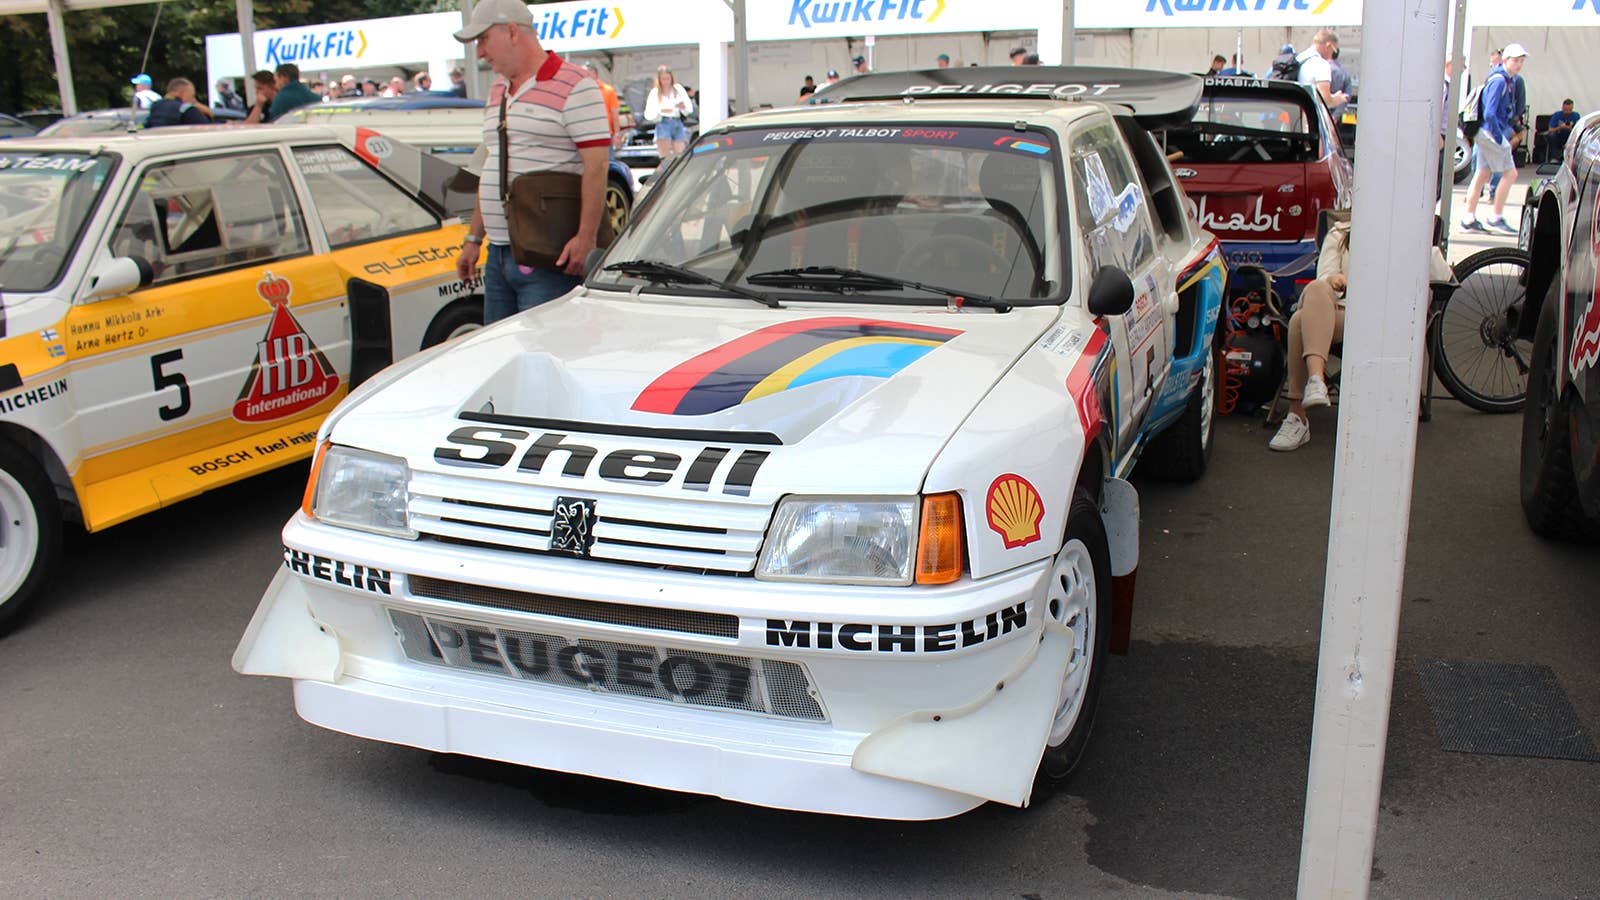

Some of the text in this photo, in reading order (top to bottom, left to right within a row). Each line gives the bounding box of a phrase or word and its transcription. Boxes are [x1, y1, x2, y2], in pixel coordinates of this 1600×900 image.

[533, 8, 609, 40] ikFit
[763, 128, 958, 141] PEUGEOT TALBOT SPORT
[11, 156, 98, 172] TEAM
[363, 243, 464, 275] quattr
[149, 348, 191, 422] 5
[246, 380, 328, 417] international
[188, 428, 320, 476] BOSCH fuel inje
[433, 425, 771, 497] Shell
[766, 602, 1028, 653] MICHELIN
[426, 623, 757, 703] PEUGEOT
